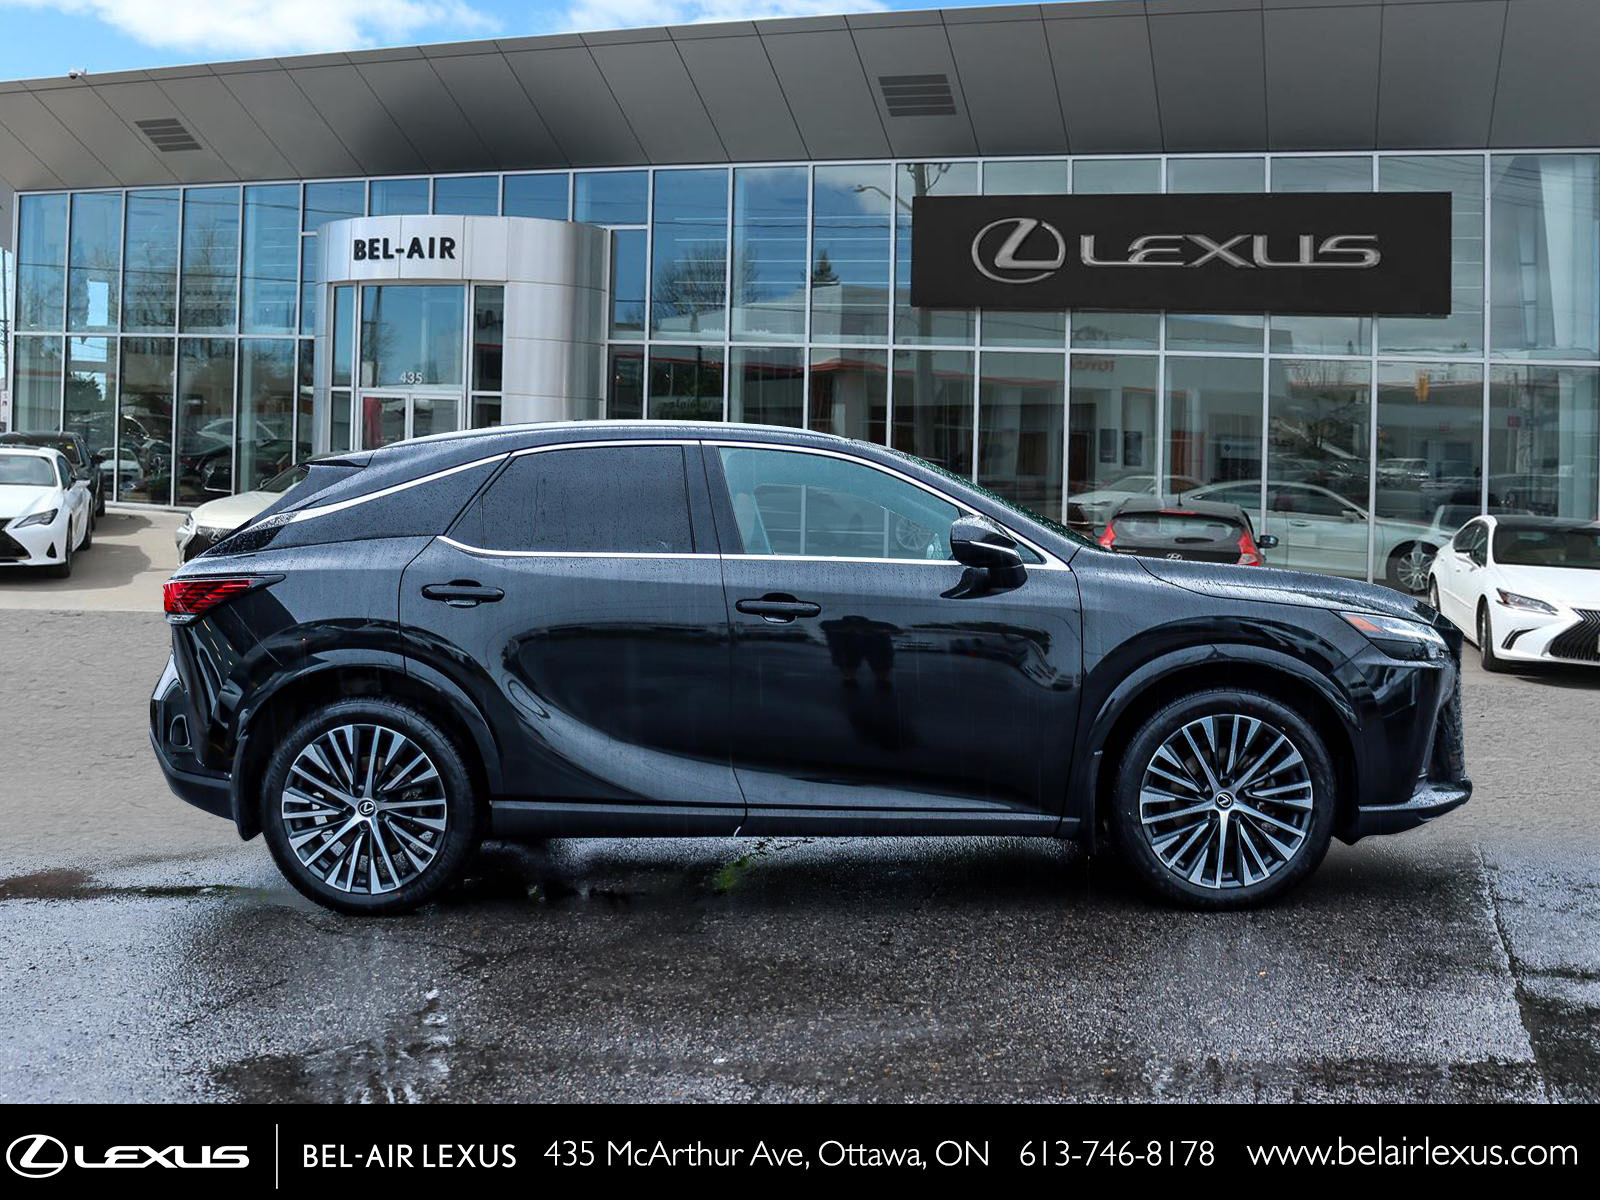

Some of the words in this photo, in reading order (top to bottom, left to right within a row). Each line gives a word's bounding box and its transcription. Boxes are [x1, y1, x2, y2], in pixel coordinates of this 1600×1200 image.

[353, 236, 456, 261] BEL-AIR
[1080, 234, 1381, 268] LEXUS
[400, 371, 423, 385] 435
